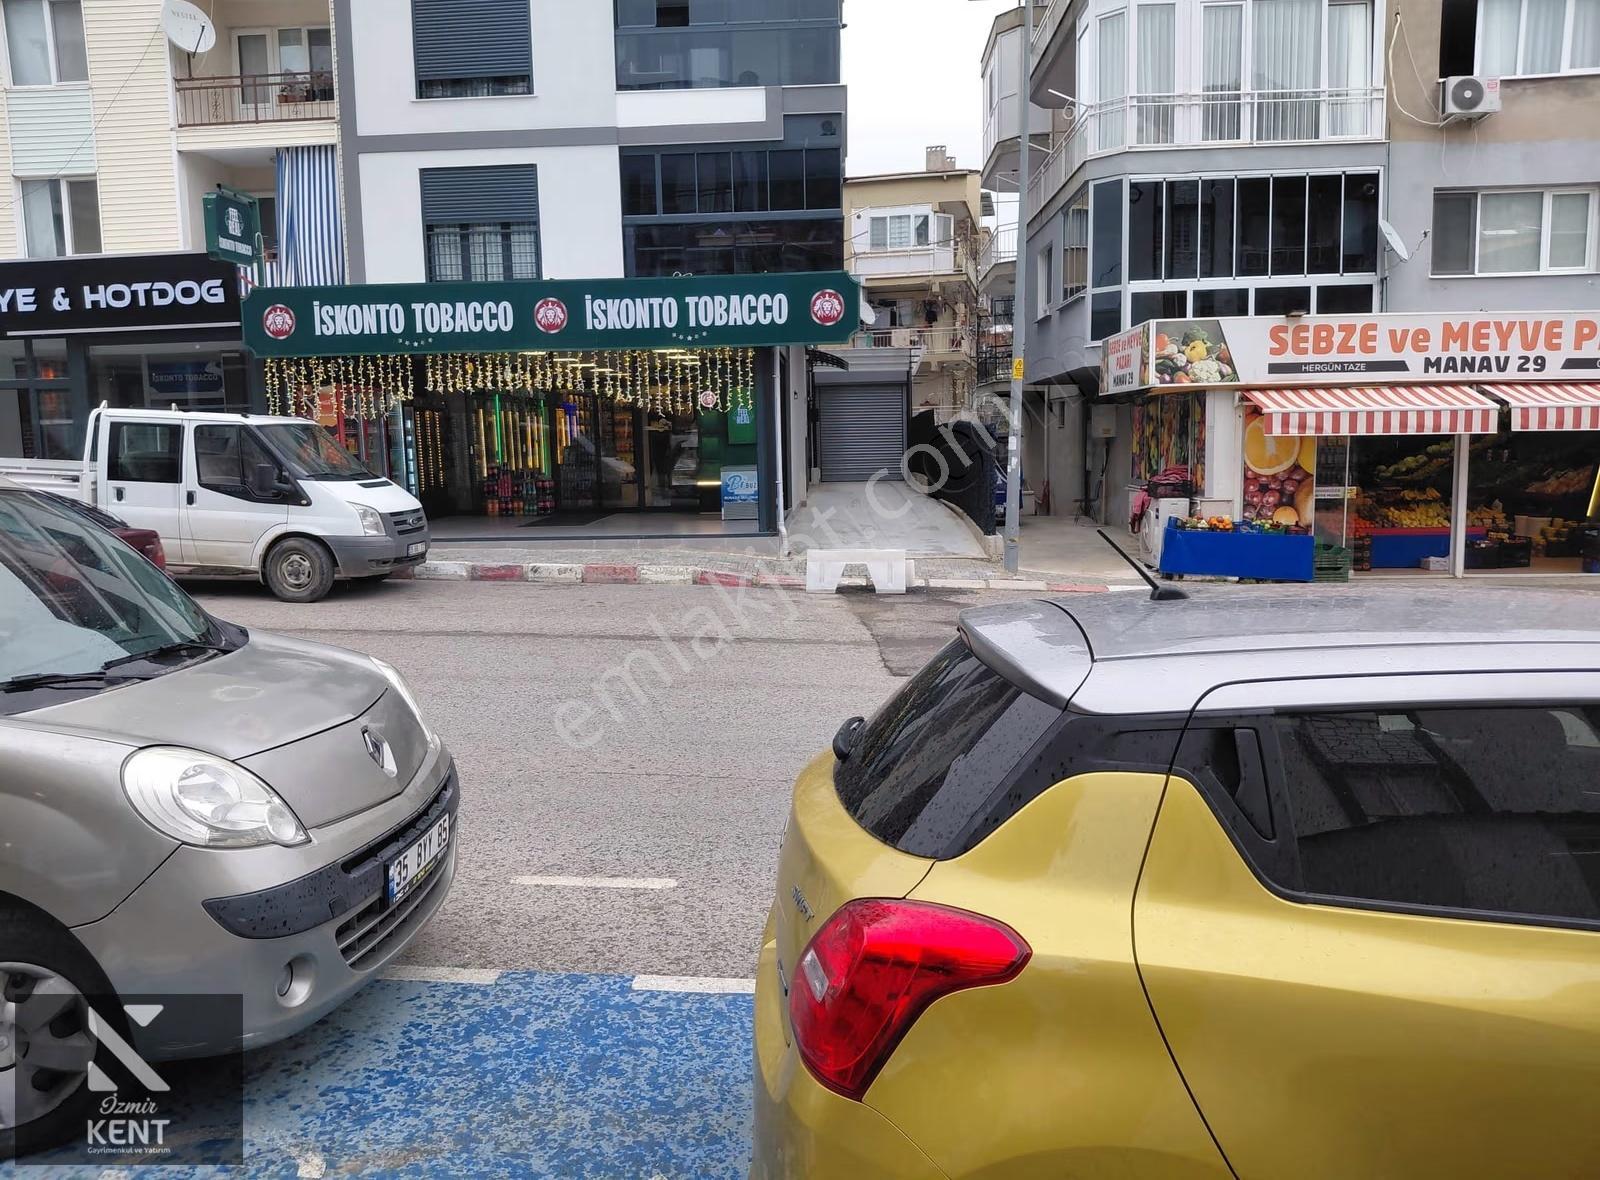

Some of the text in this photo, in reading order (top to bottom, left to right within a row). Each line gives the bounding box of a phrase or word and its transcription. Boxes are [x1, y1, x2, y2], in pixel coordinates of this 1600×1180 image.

[53, 287, 71, 311] &
[83, 279, 225, 309] HOTDOG
[585, 293, 788, 330] İSKONTO TOBACCO
[313, 301, 513, 336] İSKONTO TOBACCO
[1269, 323, 1378, 356] SEBZE
[1388, 328, 1431, 353] ve
[1441, 320, 1563, 352] MEYVE
[1343, 362, 1367, 371] TAZE
[1423, 355, 1547, 374] MANAV 29
[396, 854, 408, 887] 35
[417, 834, 433, 868] BYY
[438, 819, 447, 849] 85
